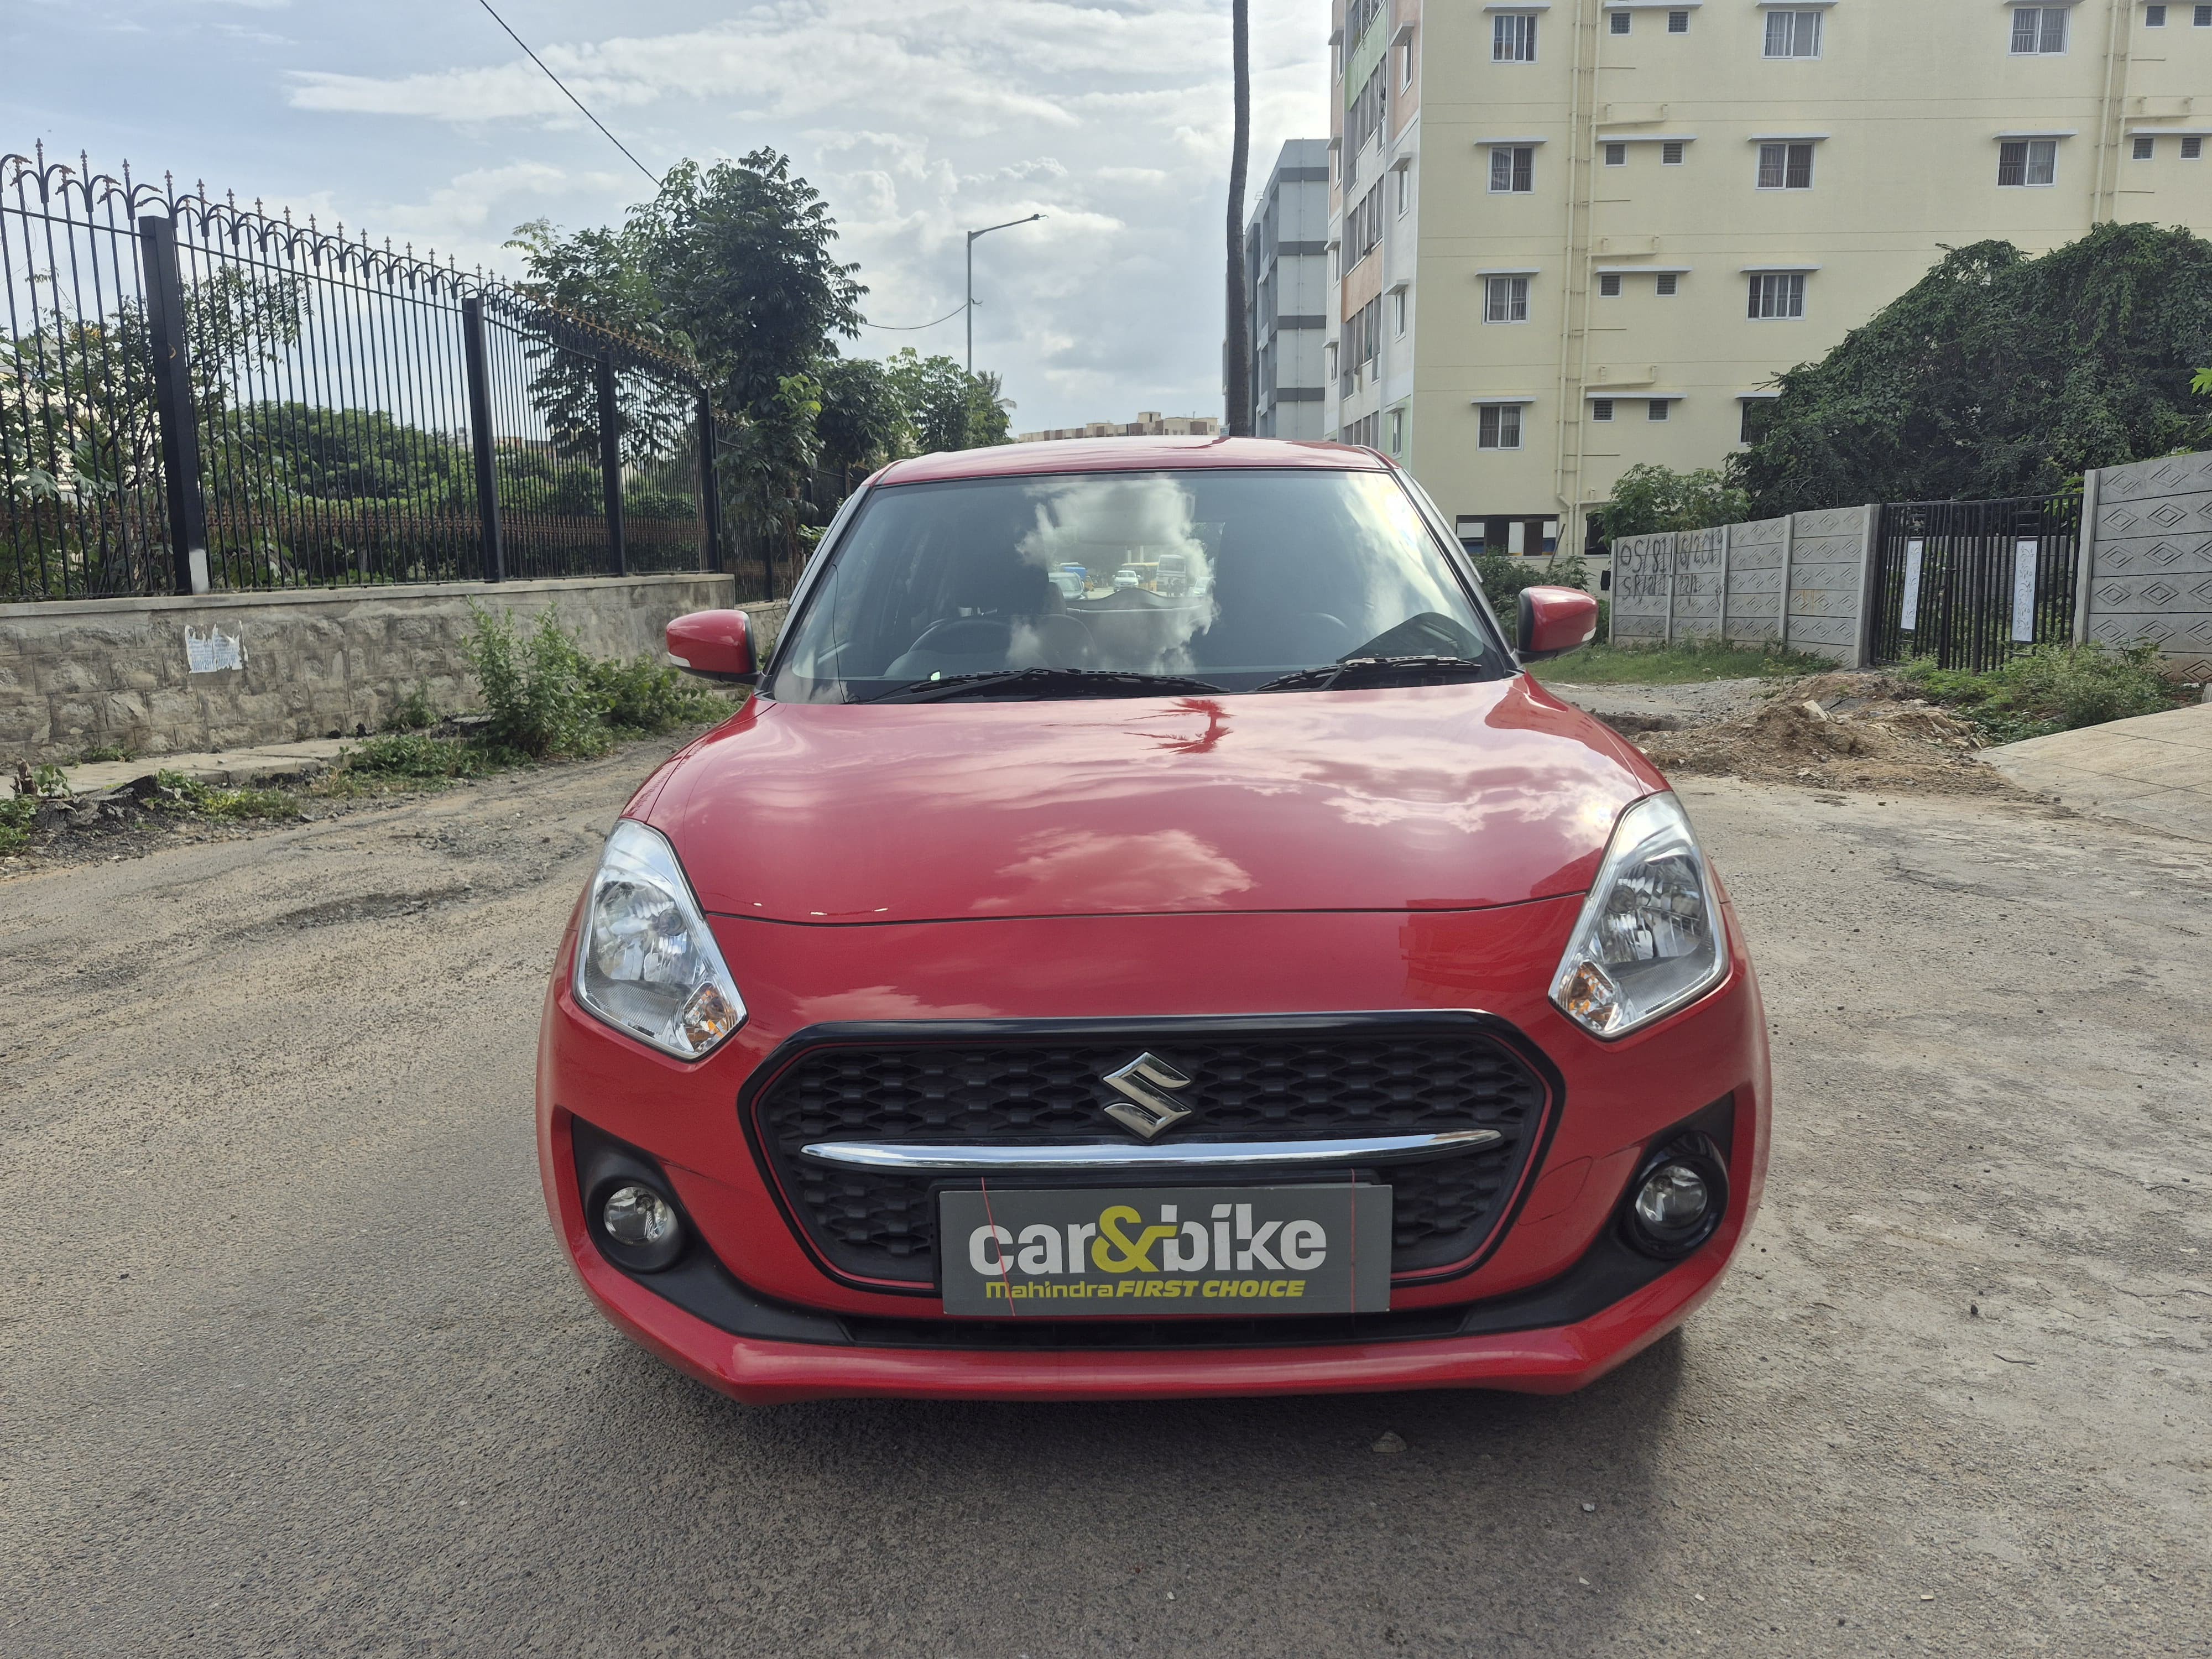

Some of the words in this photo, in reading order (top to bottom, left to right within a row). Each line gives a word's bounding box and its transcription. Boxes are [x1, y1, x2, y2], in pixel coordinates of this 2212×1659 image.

[969, 1203, 1327, 1276] car&bike
[986, 1281, 1114, 1298] Mahindra
[1116, 1280, 1199, 1297] FIRST
[1202, 1280, 1306, 1297] CHOICE
